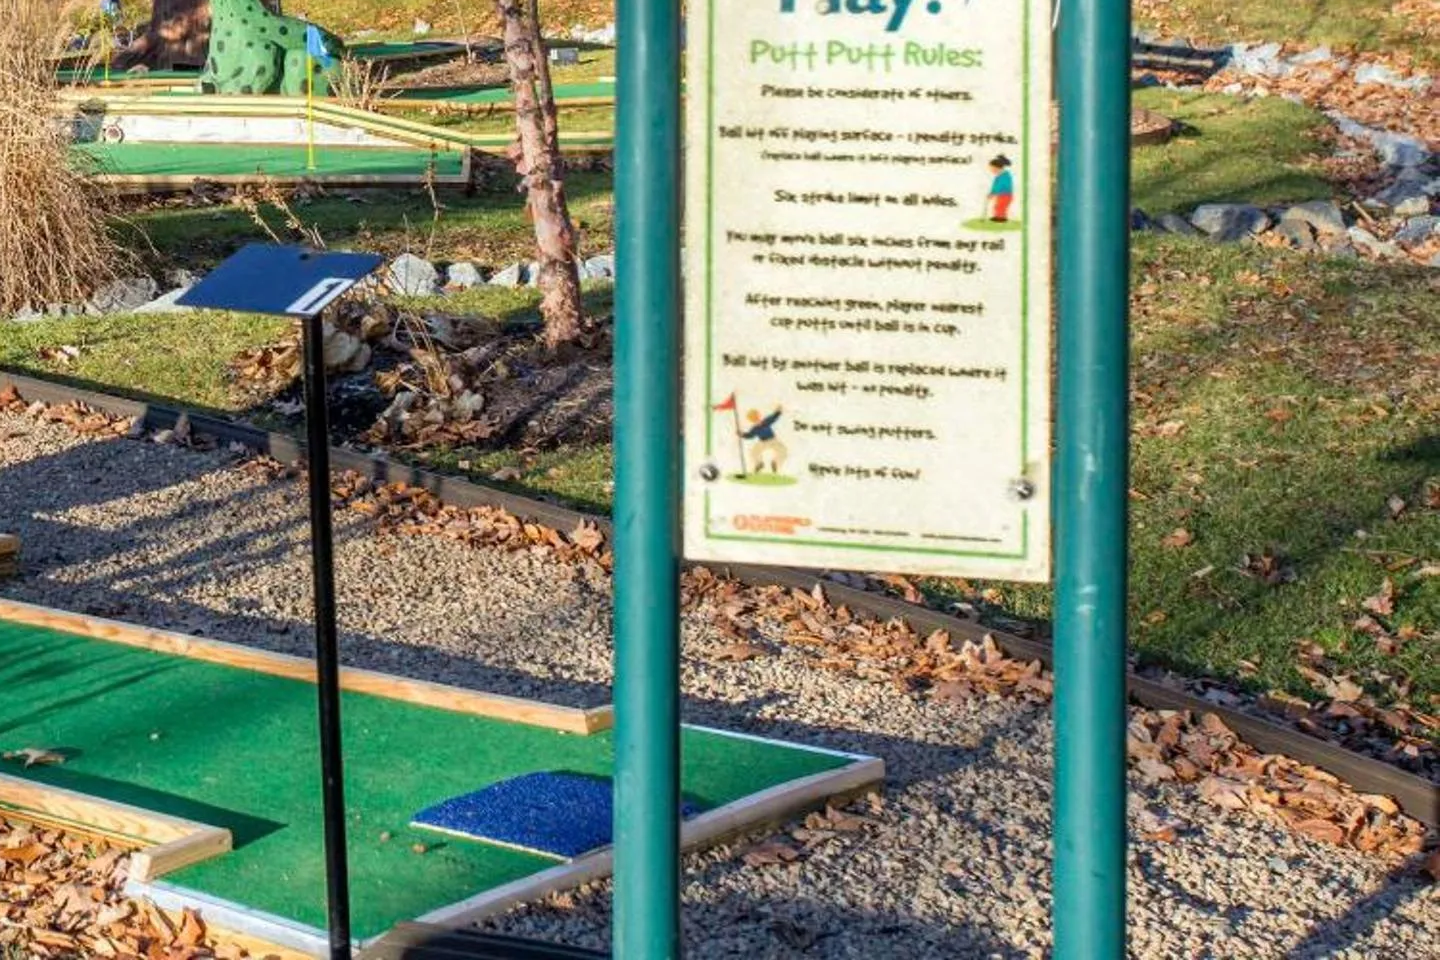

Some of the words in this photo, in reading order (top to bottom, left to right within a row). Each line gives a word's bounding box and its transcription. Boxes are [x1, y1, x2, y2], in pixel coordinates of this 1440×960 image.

[750, 40, 818, 70] Putt
[826, 41, 896, 71] Putt
[903, 41, 983, 69] Rules:
[303, 281, 343, 311] 1
